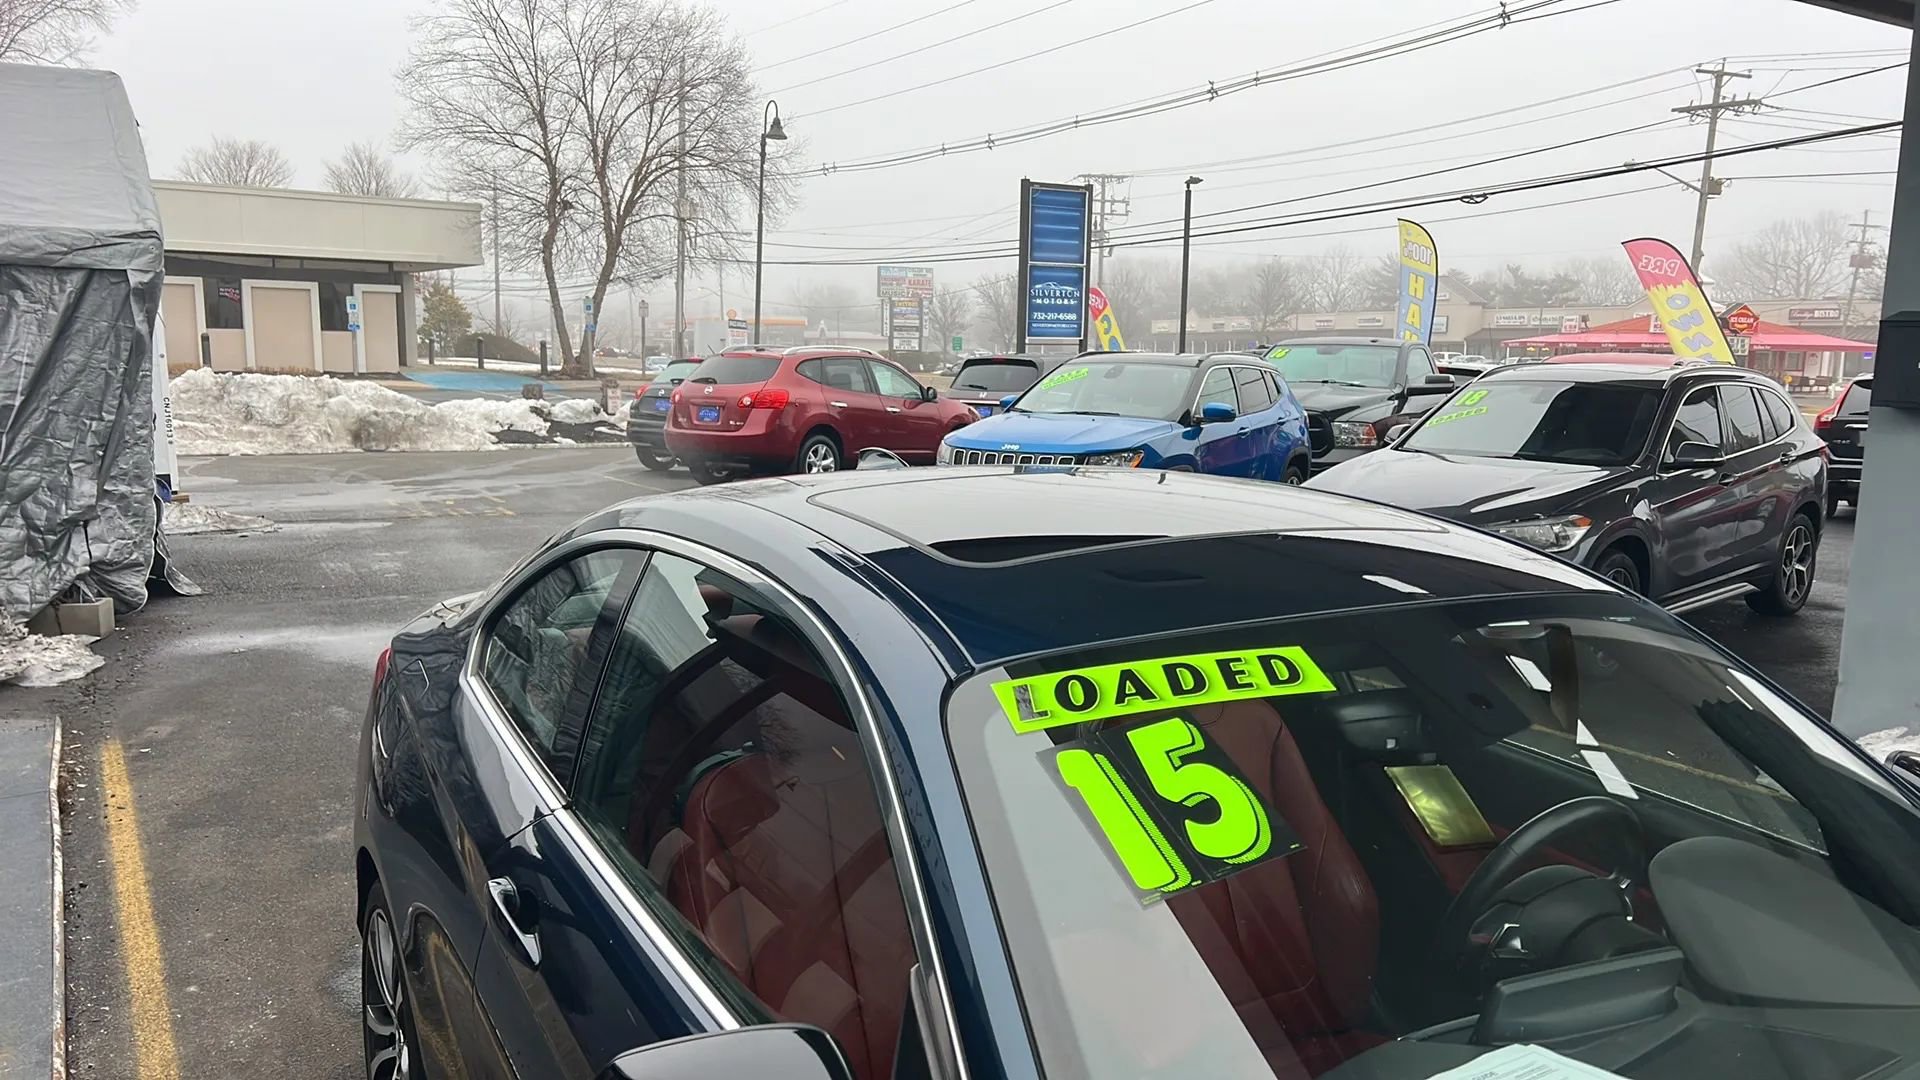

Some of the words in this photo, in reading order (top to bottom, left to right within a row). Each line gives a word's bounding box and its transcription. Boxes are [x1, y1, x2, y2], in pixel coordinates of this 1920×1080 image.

[1030, 288, 1080, 298] SILVERTON
[1814, 310, 1839, 318] BISTRO
[1455, 388, 1489, 406] 18
[1001, 443, 1020, 451] Jeep
[1012, 653, 1305, 723] LOADED
[1055, 717, 1273, 891] 15
